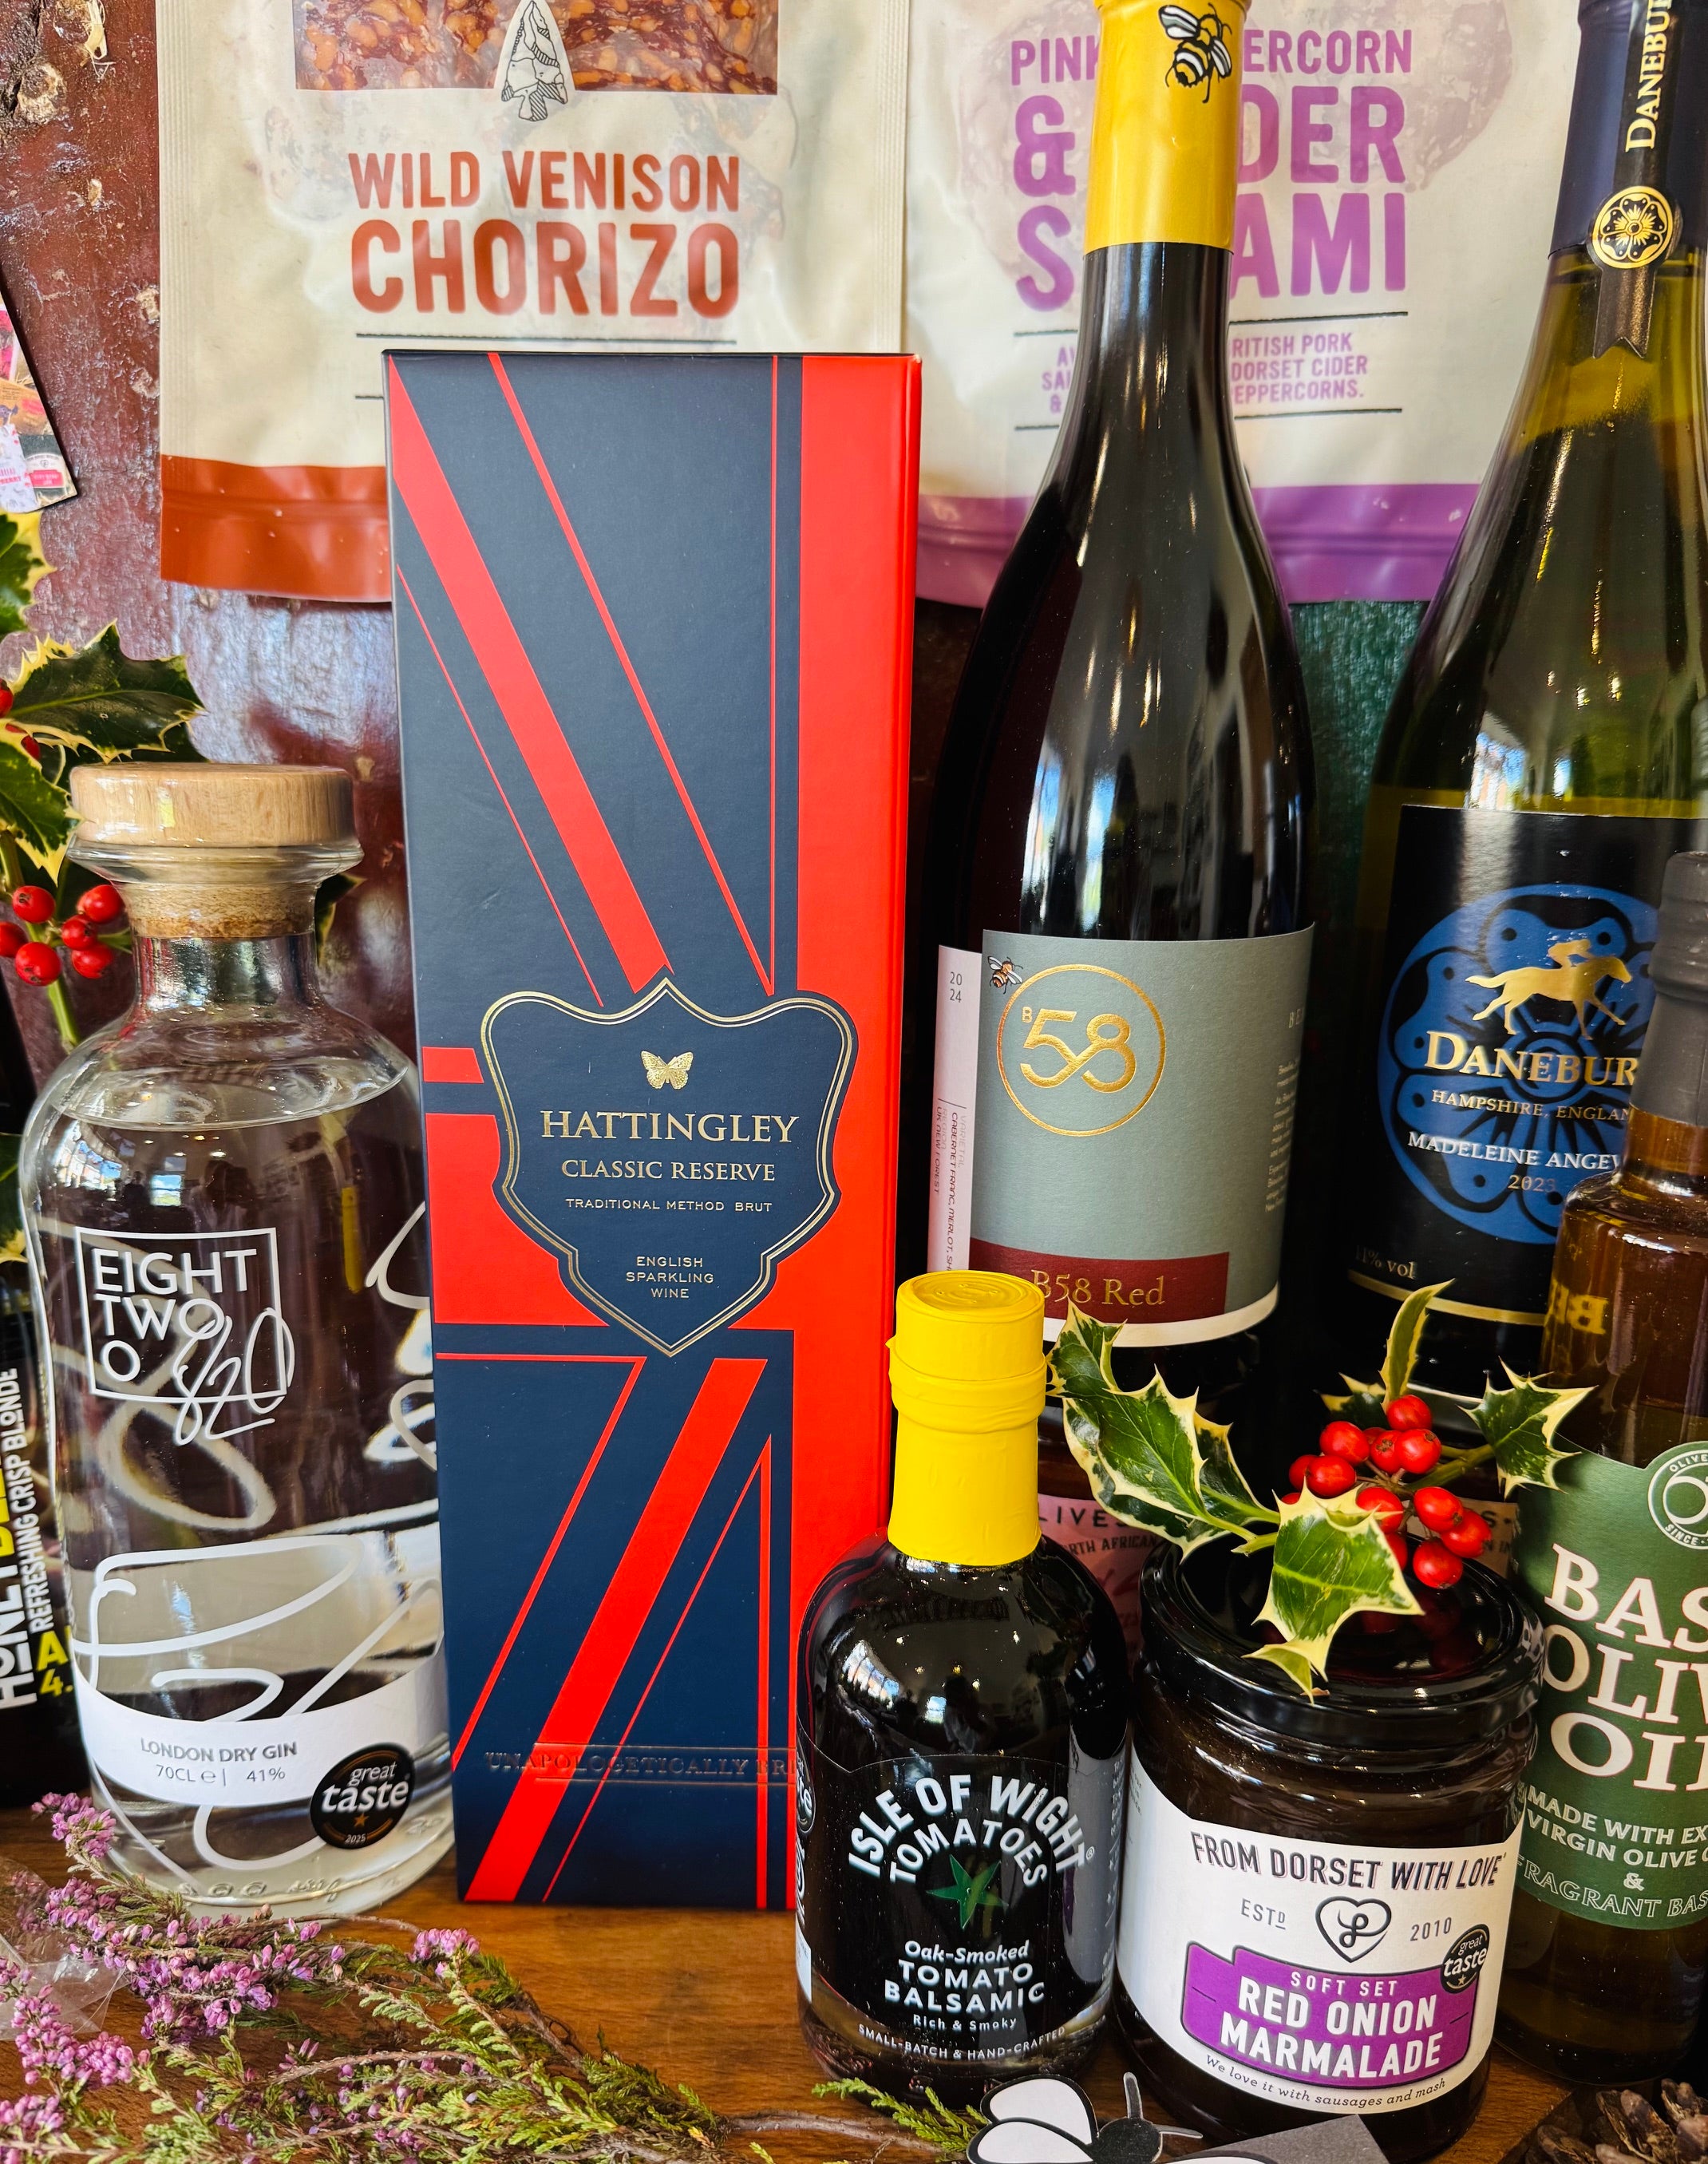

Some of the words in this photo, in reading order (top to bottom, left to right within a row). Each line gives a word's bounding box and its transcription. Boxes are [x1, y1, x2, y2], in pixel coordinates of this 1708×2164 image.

[1243, 29, 1412, 73] ERCORN
[1625, 0, 1673, 152] DANEBU
[1014, 95, 1075, 196] &
[1238, 84, 1406, 184] DER
[348, 151, 480, 209] WILD
[502, 150, 739, 213] VENISON
[351, 219, 739, 319] CHORIZO
[1232, 335, 1294, 358] RITISH
[1301, 332, 1353, 353] PORK
[1232, 358, 1305, 382] DORSET
[1311, 355, 1368, 376] CIDER
[1234, 379, 1366, 405] EPPERCORNS.
[949, 971, 963, 987] 20
[949, 989, 963, 1003] 24
[1424, 1031, 1639, 1086] DANEBUR
[1432, 1090, 1549, 1118] HAMPSHIRE,
[1556, 1106, 1630, 1121] ENGLAN
[540, 1110, 799, 1142] HATTINGLEY
[1408, 1132, 1539, 1166] MADELEINE
[562, 1159, 662, 1180] CLASSIC
[670, 1162, 775, 1181] RESERVE
[1508, 1175, 1556, 1193] 2023
[566, 1199, 660, 1210] TRADITIONAL
[666, 1201, 725, 1211] METHOD
[735, 1202, 772, 1213] BRUT
[91, 1248, 257, 1295] EIGHT
[636, 1256, 703, 1268] ENGLISH
[1386, 1260, 1416, 1280] vol
[626, 1272, 714, 1284] SPARKLING
[650, 1288, 690, 1298] WINE
[1030, 1270, 1092, 1304] B58
[1101, 1276, 1165, 1306] Red
[93, 1292, 224, 1341] TWO
[0, 1367, 29, 1453] BLONDE
[5, 1454, 37, 1514] CRISP
[1665, 1524, 1698, 1546] SINCE
[13, 1513, 54, 1634] REFRESHING
[1544, 1543, 1708, 1653] BAS
[140, 1738, 214, 1762] LONDON
[219, 1747, 258, 1762] DRY
[262, 1741, 298, 1758] GIN
[485, 1751, 749, 1775] UNAPOLOGETICALLY
[156, 1764, 196, 1782] 70CL
[246, 1766, 286, 1782] 41%
[350, 1761, 397, 1788] great
[322, 1778, 409, 1814] taste
[848, 1789, 914, 1878] ISLE
[915, 1774, 971, 1814] OF
[1528, 1784, 1598, 1832] MADE
[1603, 1818, 1674, 1846] WITH
[344, 1833, 366, 1845] 2025
[890, 1818, 1047, 1888] TOMATOES
[1527, 1808, 1616, 1861] VIRGIN
[1623, 1849, 1698, 1868] OLIVE
[1191, 1830, 1261, 1874] FROM
[1270, 1848, 1382, 1889] DORSET
[1390, 1861, 1455, 1891] WITH
[1623, 1872, 1645, 1891] &
[1667, 1889, 1708, 1917] BAS
[1410, 1917, 1452, 1941] 2010
[904, 1940, 1030, 1964] Oak-Smoked
[1458, 1934, 1484, 1956] great
[898, 1959, 1033, 1990] TOMATO
[1443, 1948, 1487, 1976] taste
[884, 1980, 1046, 2013] BALSAMIC
[1290, 1971, 1346, 1996] SOFT
[1359, 1980, 1398, 1996] SET
[1238, 1976, 1309, 2029] RED
[1326, 1994, 1438, 2036] ONION
[913, 2014, 945, 2030] Rich
[952, 2020, 963, 2031] &
[969, 2018, 1017, 2031] Smoky
[858, 2024, 948, 2059] SMALL-BATCH
[953, 2050, 962, 2060] &
[967, 2027, 1066, 2060] HAND-CRAFTED
[1220, 2012, 1443, 2079] MARMALADE
[1206, 2055, 1225, 2073] We
[1229, 2067, 1259, 2087] love
[1262, 2081, 1275, 2093] it
[1278, 2087, 1311, 2102] with
[1315, 2095, 1382, 2109] sausages
[1386, 2090, 1413, 2104] and
[1415, 2079, 1446, 2099] mash
